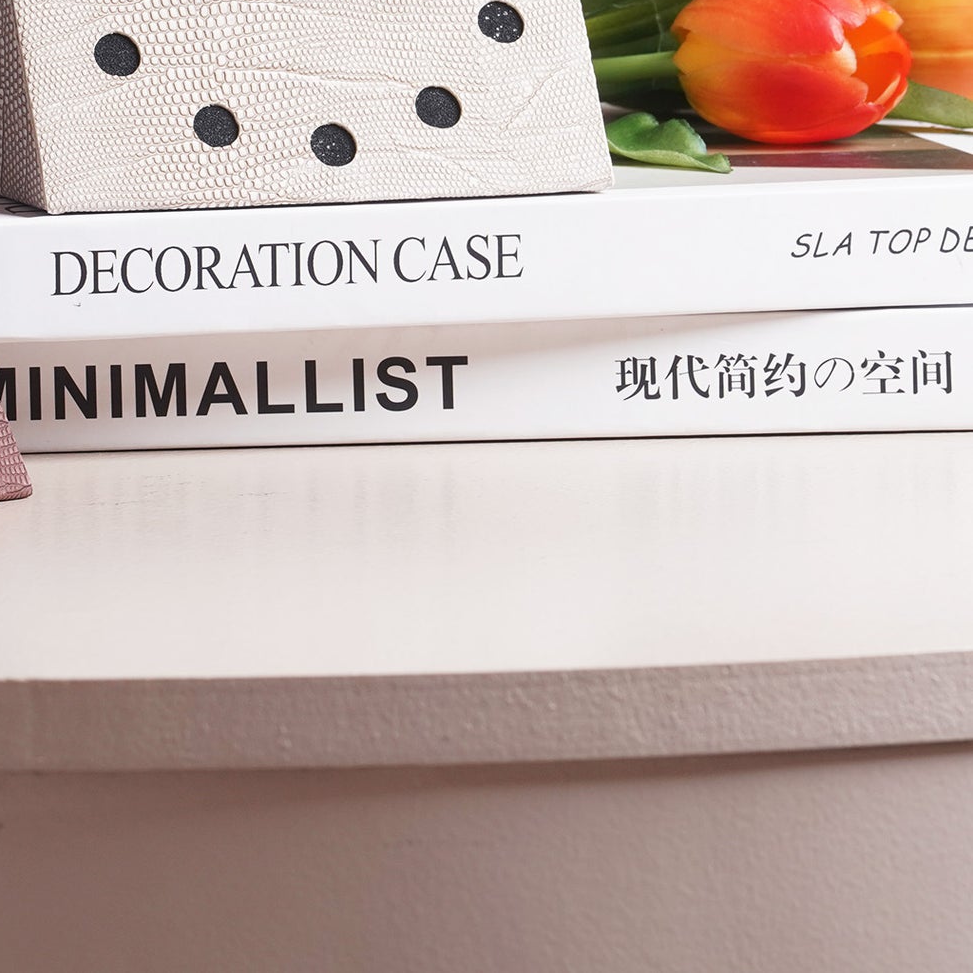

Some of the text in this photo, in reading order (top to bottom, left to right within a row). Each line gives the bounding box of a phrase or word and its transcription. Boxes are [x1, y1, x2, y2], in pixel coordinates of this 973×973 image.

[51, 233, 524, 296] DECORATION CASE
[790, 231, 853, 259] SLA
[869, 227, 932, 255] TOP
[614, 349, 954, 401] 现代简约の空间
